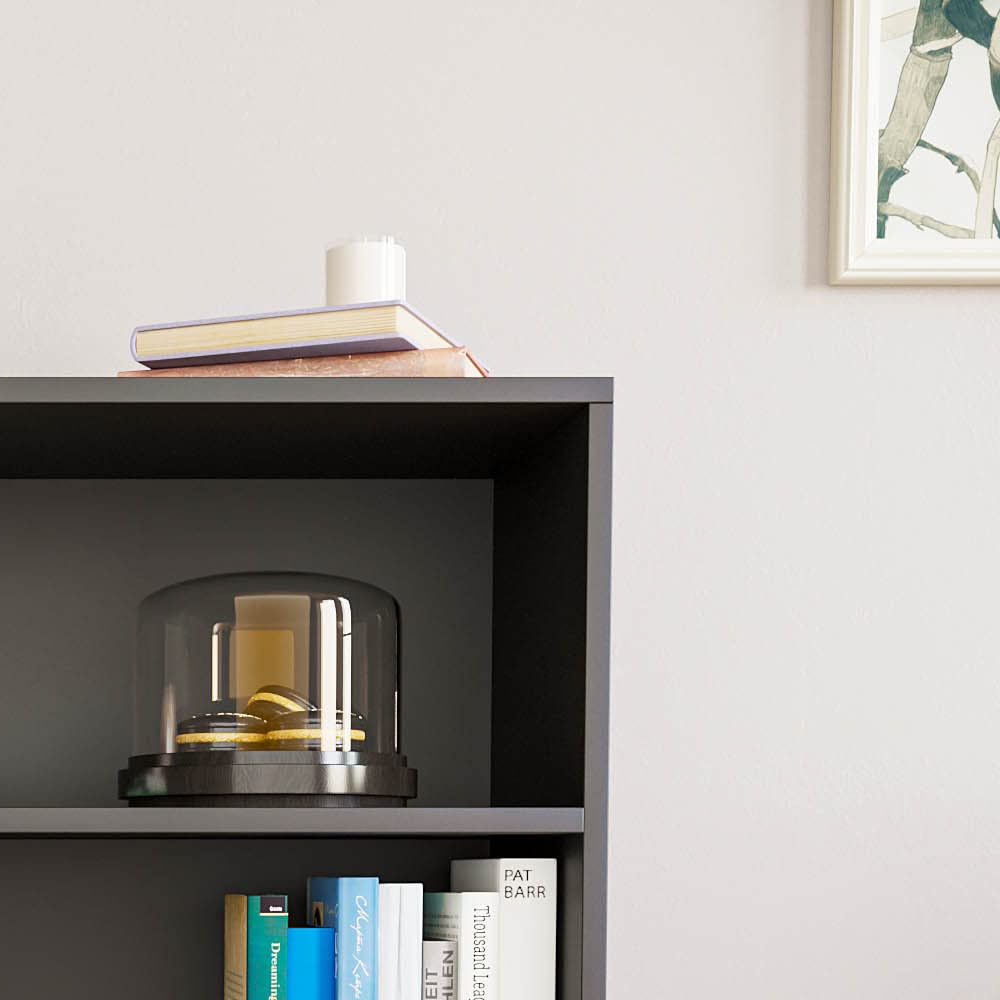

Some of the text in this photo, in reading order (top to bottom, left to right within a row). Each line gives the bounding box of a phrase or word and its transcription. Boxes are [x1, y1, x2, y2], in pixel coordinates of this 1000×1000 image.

[504, 870, 532, 881] PAT
[504, 886, 546, 898] BARR
[473, 906, 490, 971] Thousand
